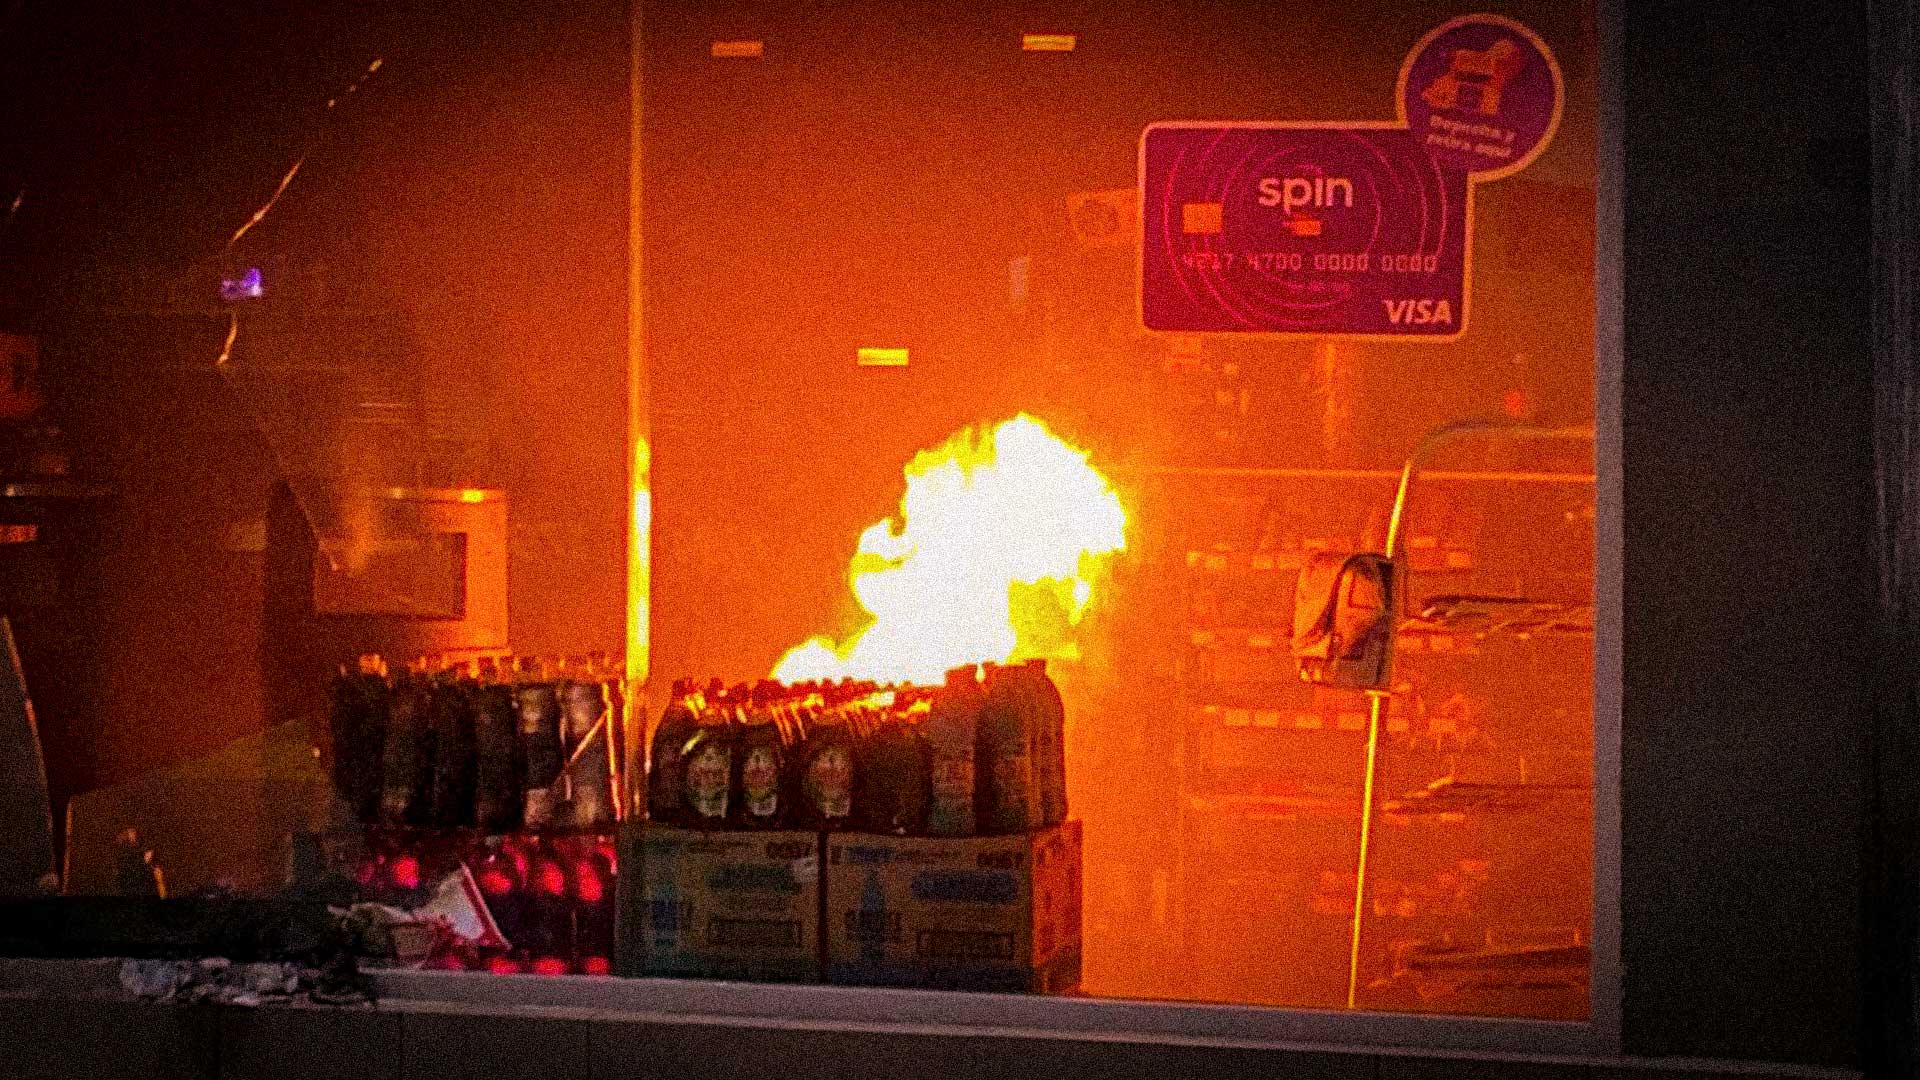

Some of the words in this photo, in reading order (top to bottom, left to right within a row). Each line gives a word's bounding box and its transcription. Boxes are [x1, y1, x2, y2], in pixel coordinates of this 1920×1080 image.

[1258, 176, 1354, 213] spin
[1248, 253, 1302, 271] 4700
[1314, 254, 1369, 271] 0000
[1381, 255, 1438, 272] 0000
[1382, 299, 1453, 325] VISA
